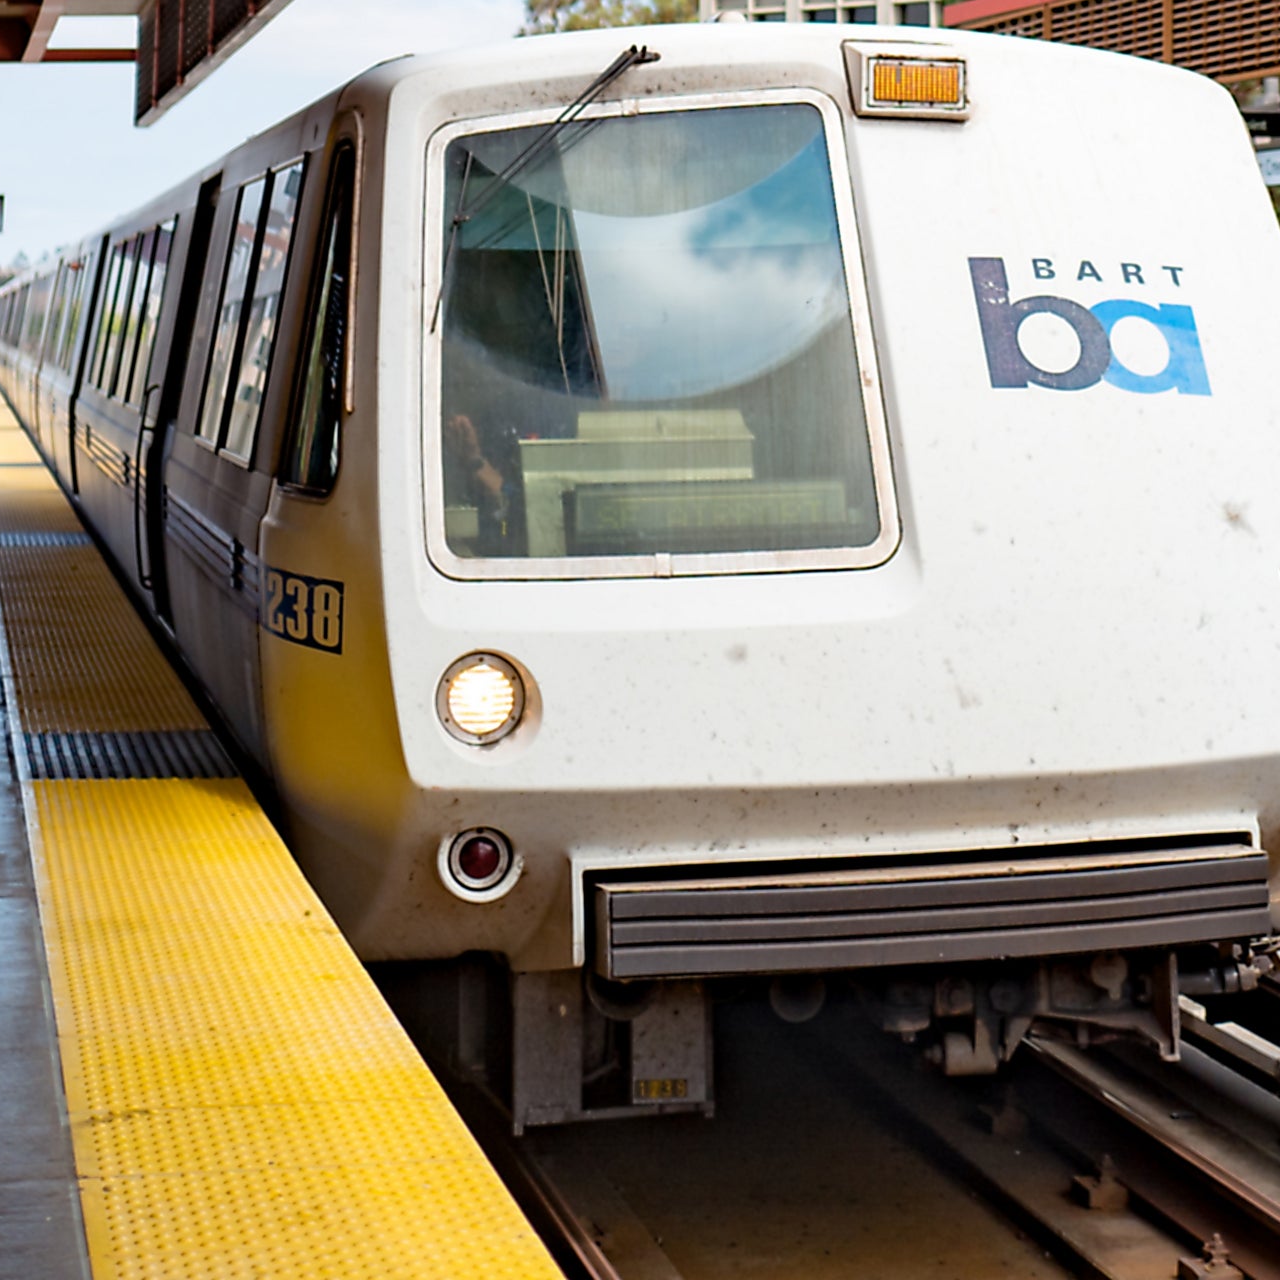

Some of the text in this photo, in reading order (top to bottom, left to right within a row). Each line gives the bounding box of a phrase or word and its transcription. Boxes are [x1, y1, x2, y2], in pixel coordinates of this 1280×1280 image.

[1032, 257, 1184, 288] BART
[967, 256, 1213, 397] ba
[267, 571, 340, 648] 238
